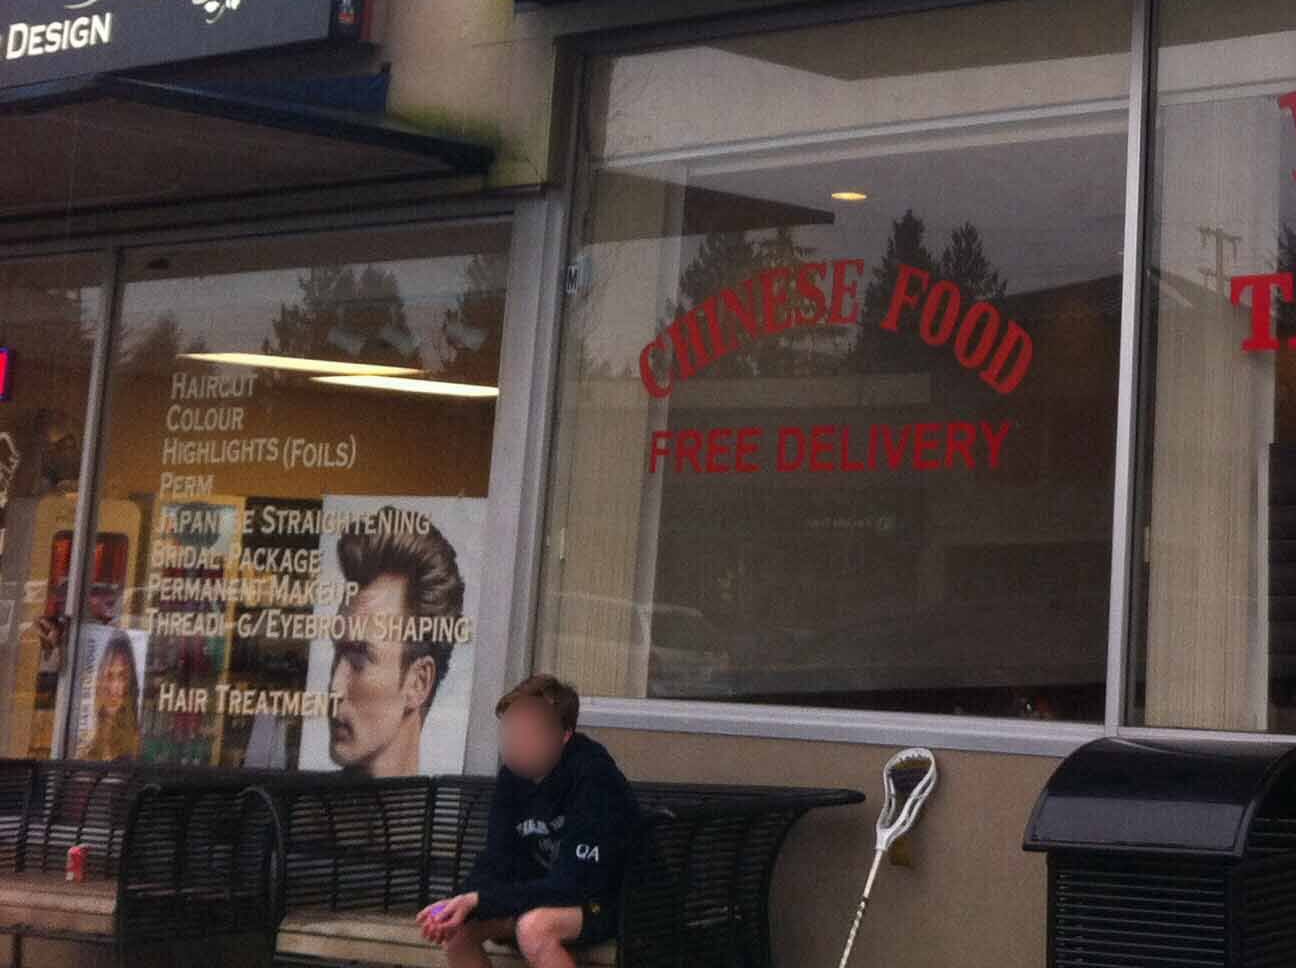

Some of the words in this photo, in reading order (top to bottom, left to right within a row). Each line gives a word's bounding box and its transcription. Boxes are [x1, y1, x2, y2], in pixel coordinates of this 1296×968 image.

[5, 12, 112, 60] DESIGN
[639, 258, 865, 399] CHINESE
[880, 264, 1034, 395] FOOD
[649, 426, 762, 474] FREE
[776, 419, 1016, 473] DELIVERY
[158, 505, 254, 534] JAPANE
[146, 607, 369, 640] THREADIG/EYEBROW
[158, 683, 207, 713] HAIR
